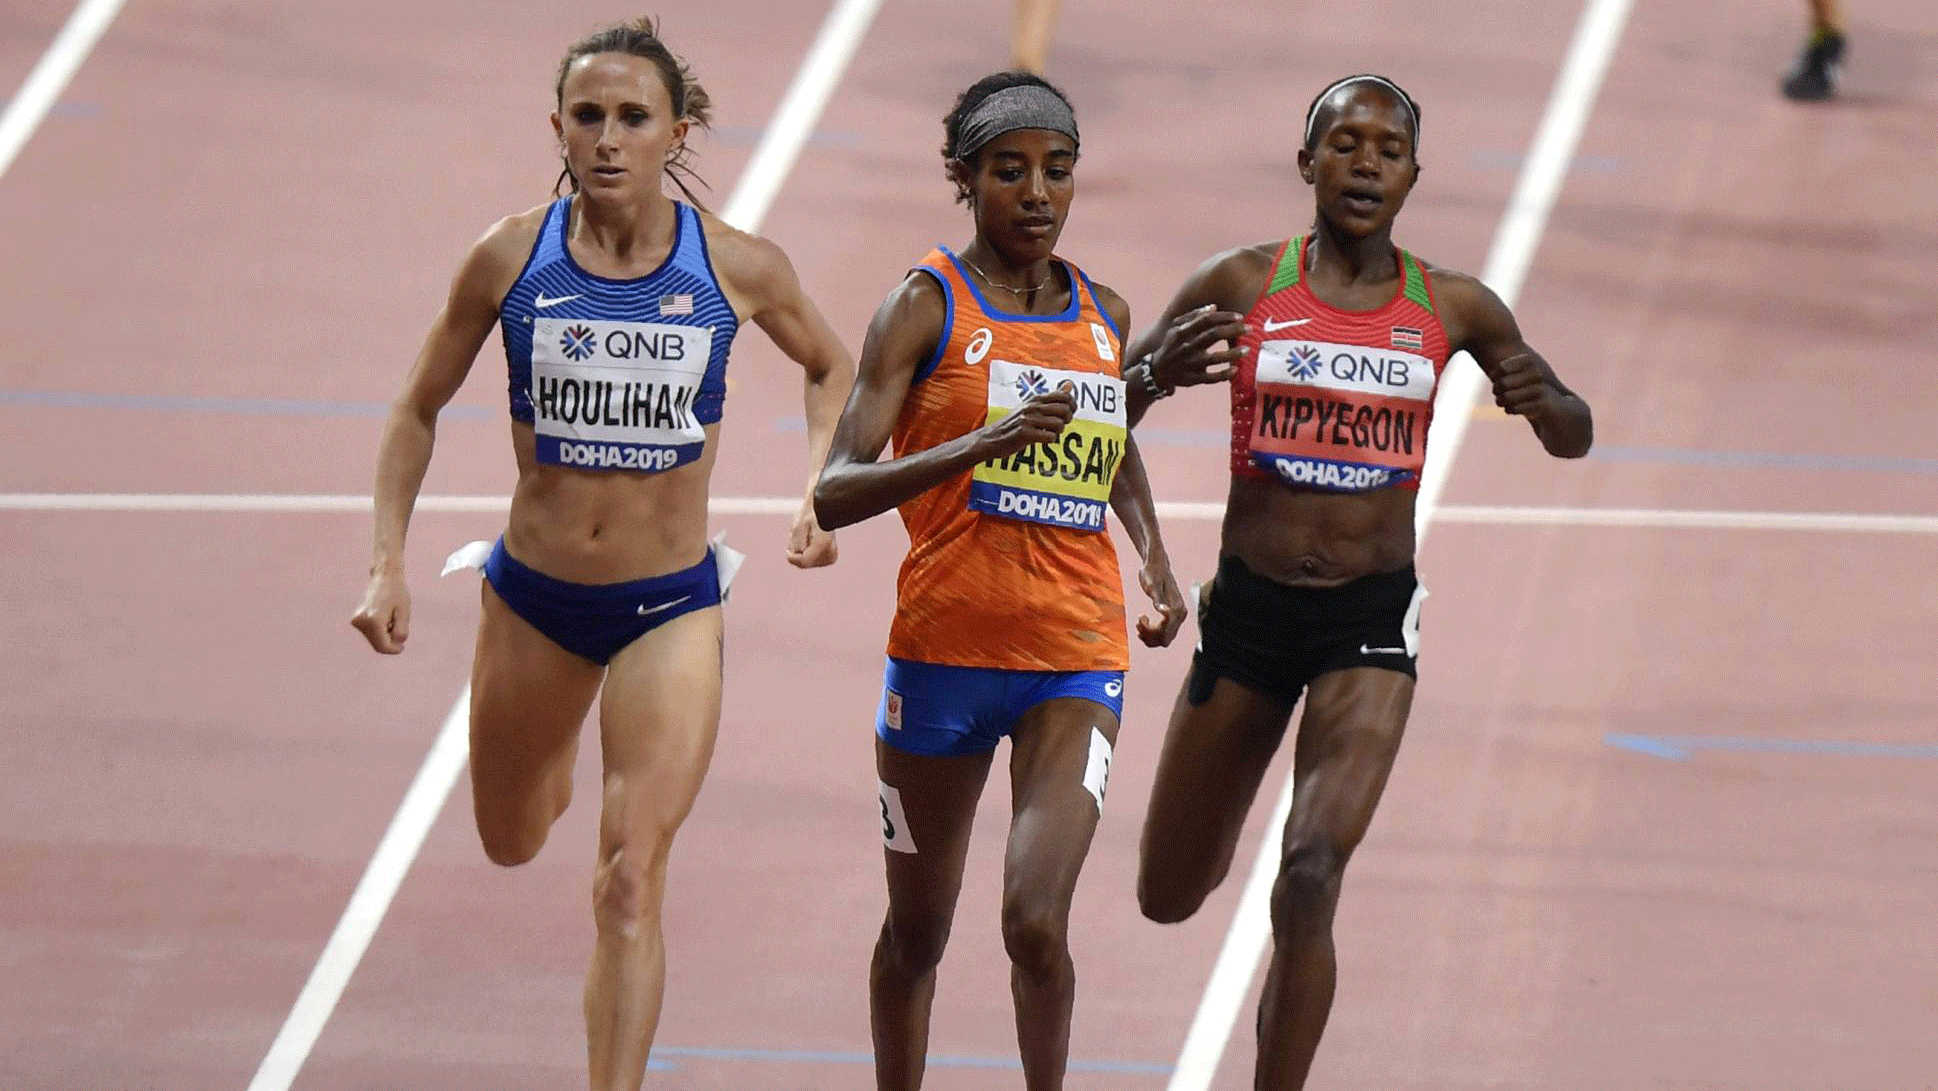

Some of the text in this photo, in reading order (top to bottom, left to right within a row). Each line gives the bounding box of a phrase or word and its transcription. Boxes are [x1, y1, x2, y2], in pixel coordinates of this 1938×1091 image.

[605, 330, 685, 360] QNB
[1331, 353, 1409, 387] QNB
[539, 376, 692, 429] HOULIHAN
[1259, 394, 1415, 455] KIPYEGON
[560, 442, 678, 469] DOHA2019
[985, 432, 1119, 487] ASSAN
